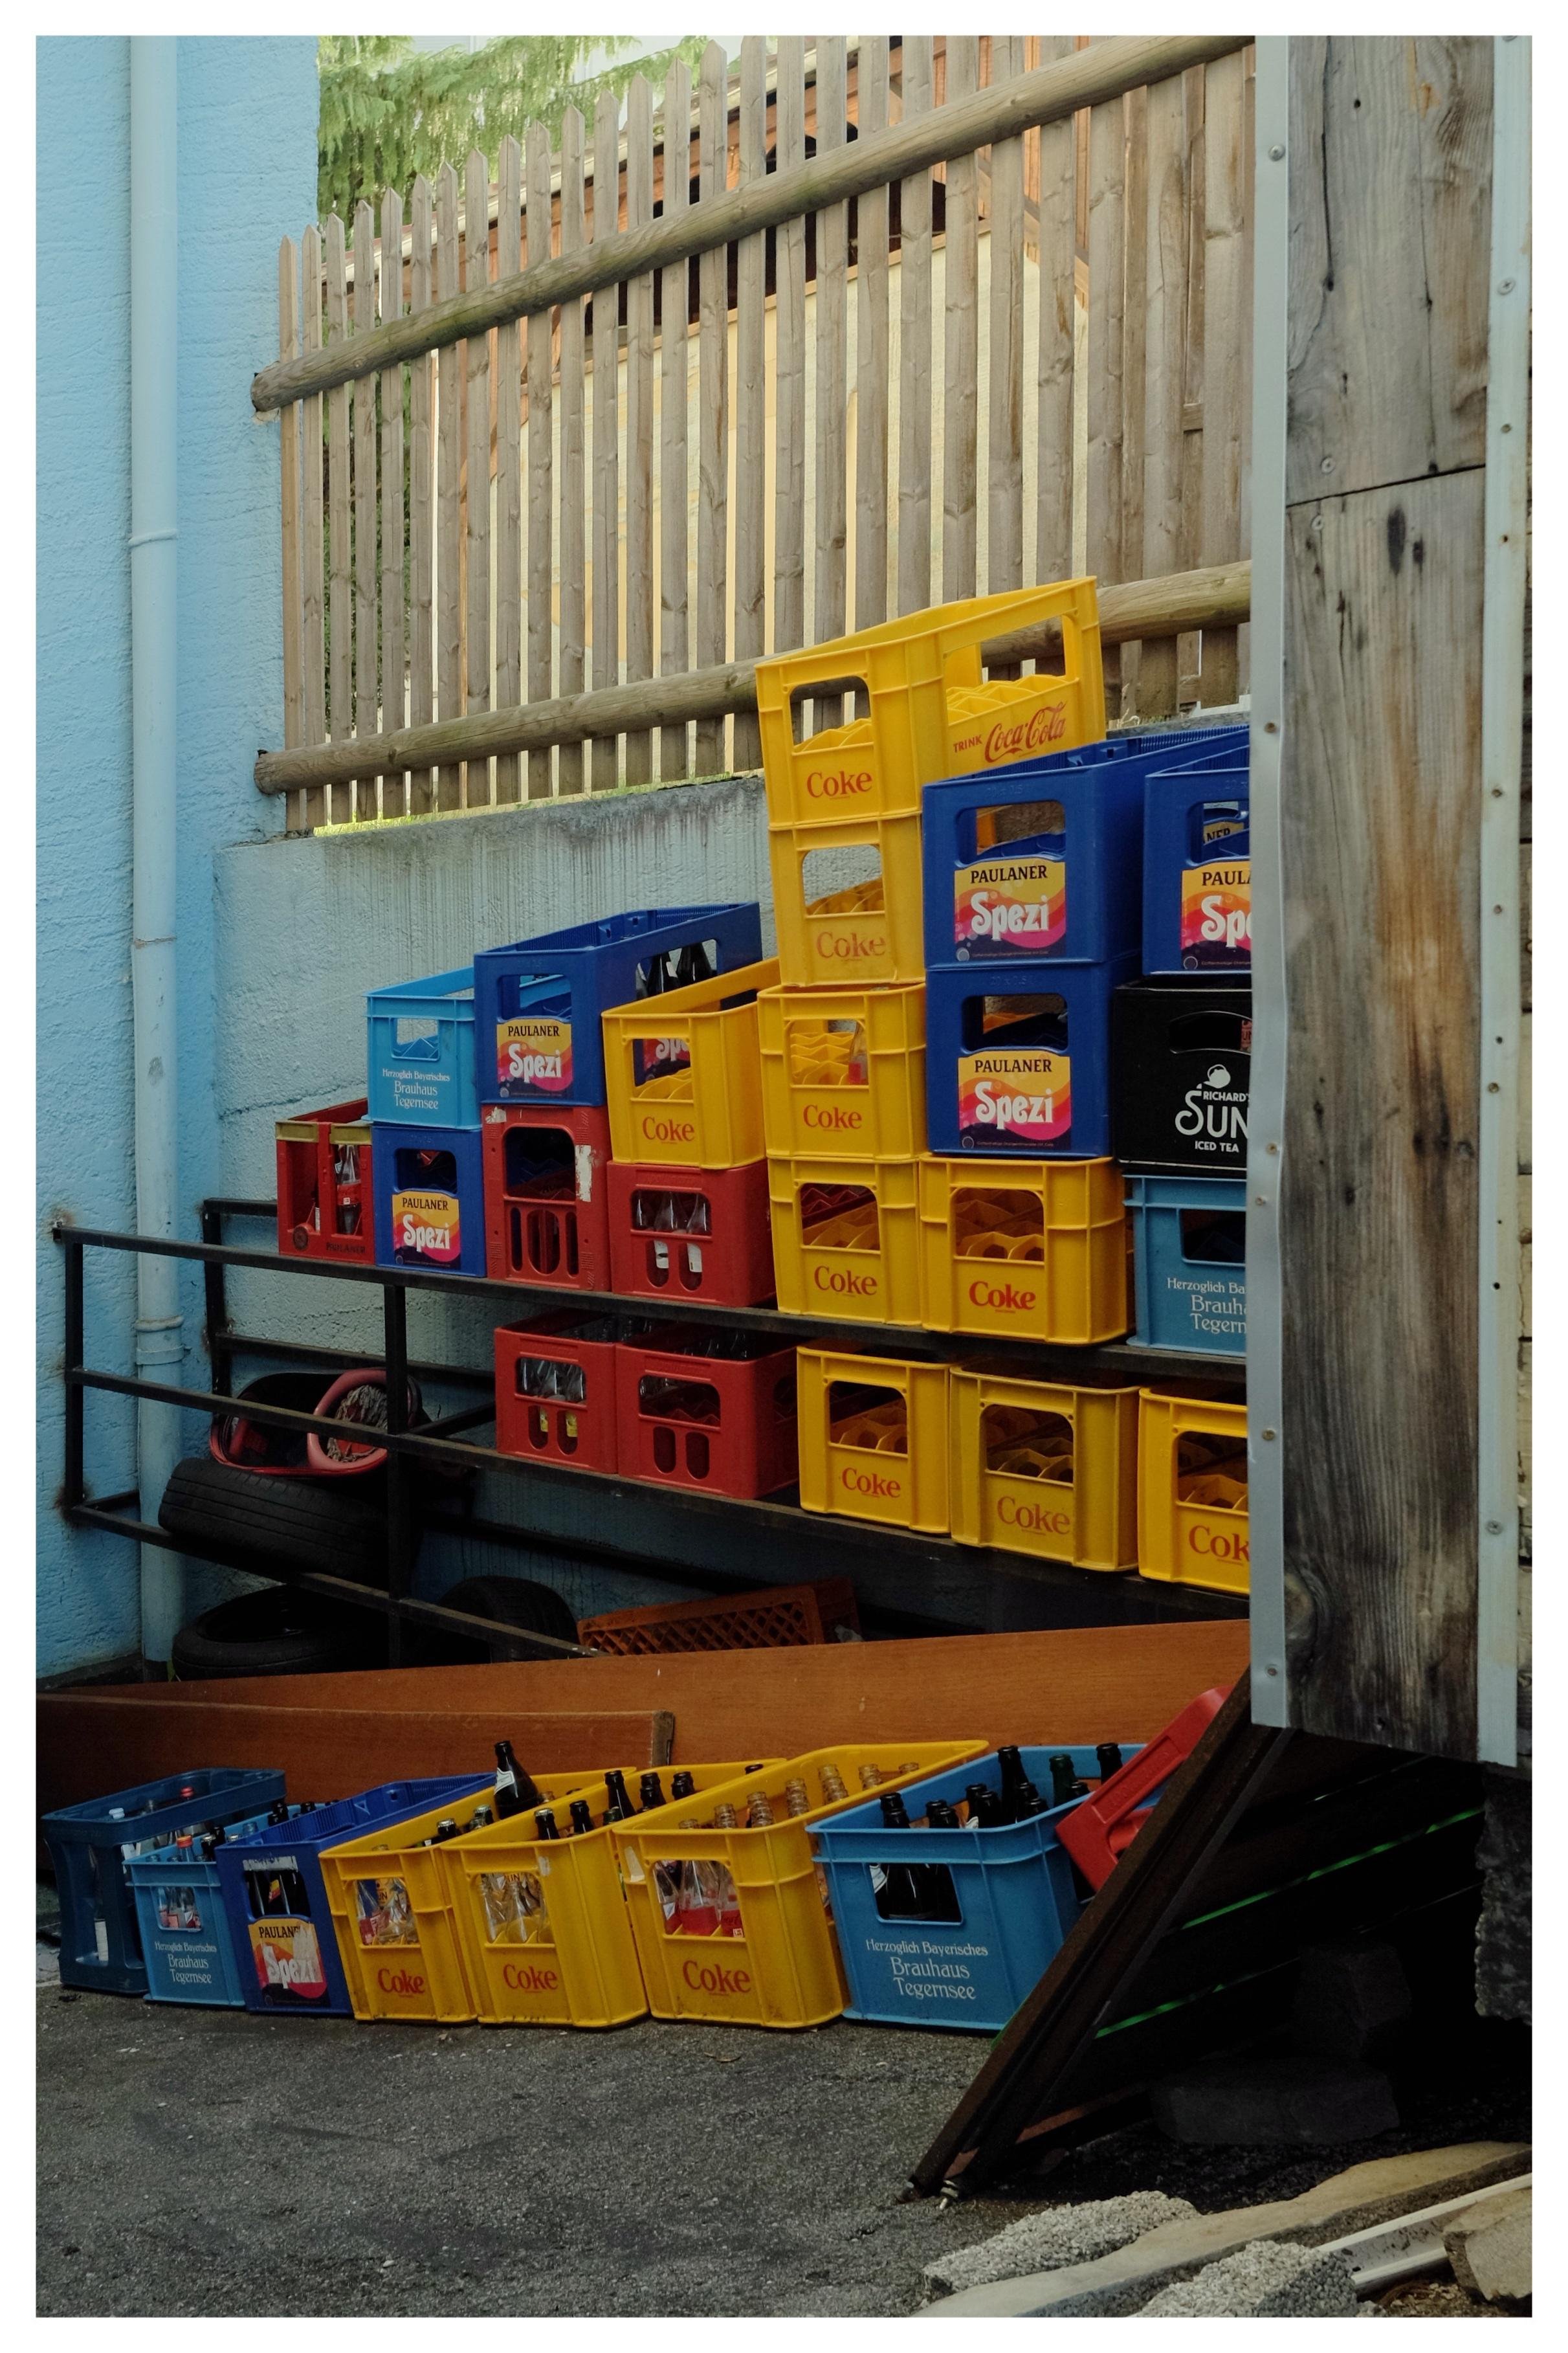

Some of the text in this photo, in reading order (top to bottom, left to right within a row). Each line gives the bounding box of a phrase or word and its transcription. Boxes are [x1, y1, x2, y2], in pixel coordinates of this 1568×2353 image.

[953, 701, 1066, 763] TRINK Coca-Cola
[807, 770, 872, 798] Coke
[971, 865, 1048, 884] PAULANER
[971, 891, 1049, 941] Spezi
[817, 932, 886, 958] Coke
[508, 1025, 560, 1036] PAULANER
[382, 1068, 450, 1082] Herzoglich Bayerisches
[509, 1043, 562, 1084] Spezi
[975, 1059, 1052, 1073] PAULANER
[394, 1080, 438, 1096] Brauhaus
[1203, 1091, 1250, 1102] RICHARD'
[394, 1093, 439, 1110] Tegernsee
[975, 1081, 1053, 1130] Spezi
[643, 1116, 694, 1141] Coke
[803, 1104, 862, 1130] Coke
[1195, 1141, 1239, 1152] ICED TEA
[403, 1198, 449, 1210] PAULANER
[403, 1214, 450, 1253] Spezi
[814, 1266, 878, 1295] Coke
[1167, 1278, 1225, 1293] Herzoglich
[969, 1281, 1036, 1310] Coke
[1191, 1295, 1247, 1315] Brauh
[842, 1467, 901, 1498] Coke
[997, 1496, 1071, 1535] Coke
[866, 1939, 989, 1957] Herzoglich Bayerisches
[168, 1954, 209, 1968] Brauhaus
[890, 1956, 970, 1979] Brauhaus
[170, 1968, 212, 1985] Tegernsee
[378, 1968, 425, 1994] Coke
[503, 1964, 558, 1990] Coke
[683, 1960, 751, 1993] Coke
[893, 1977, 977, 2000] Tegernsee
